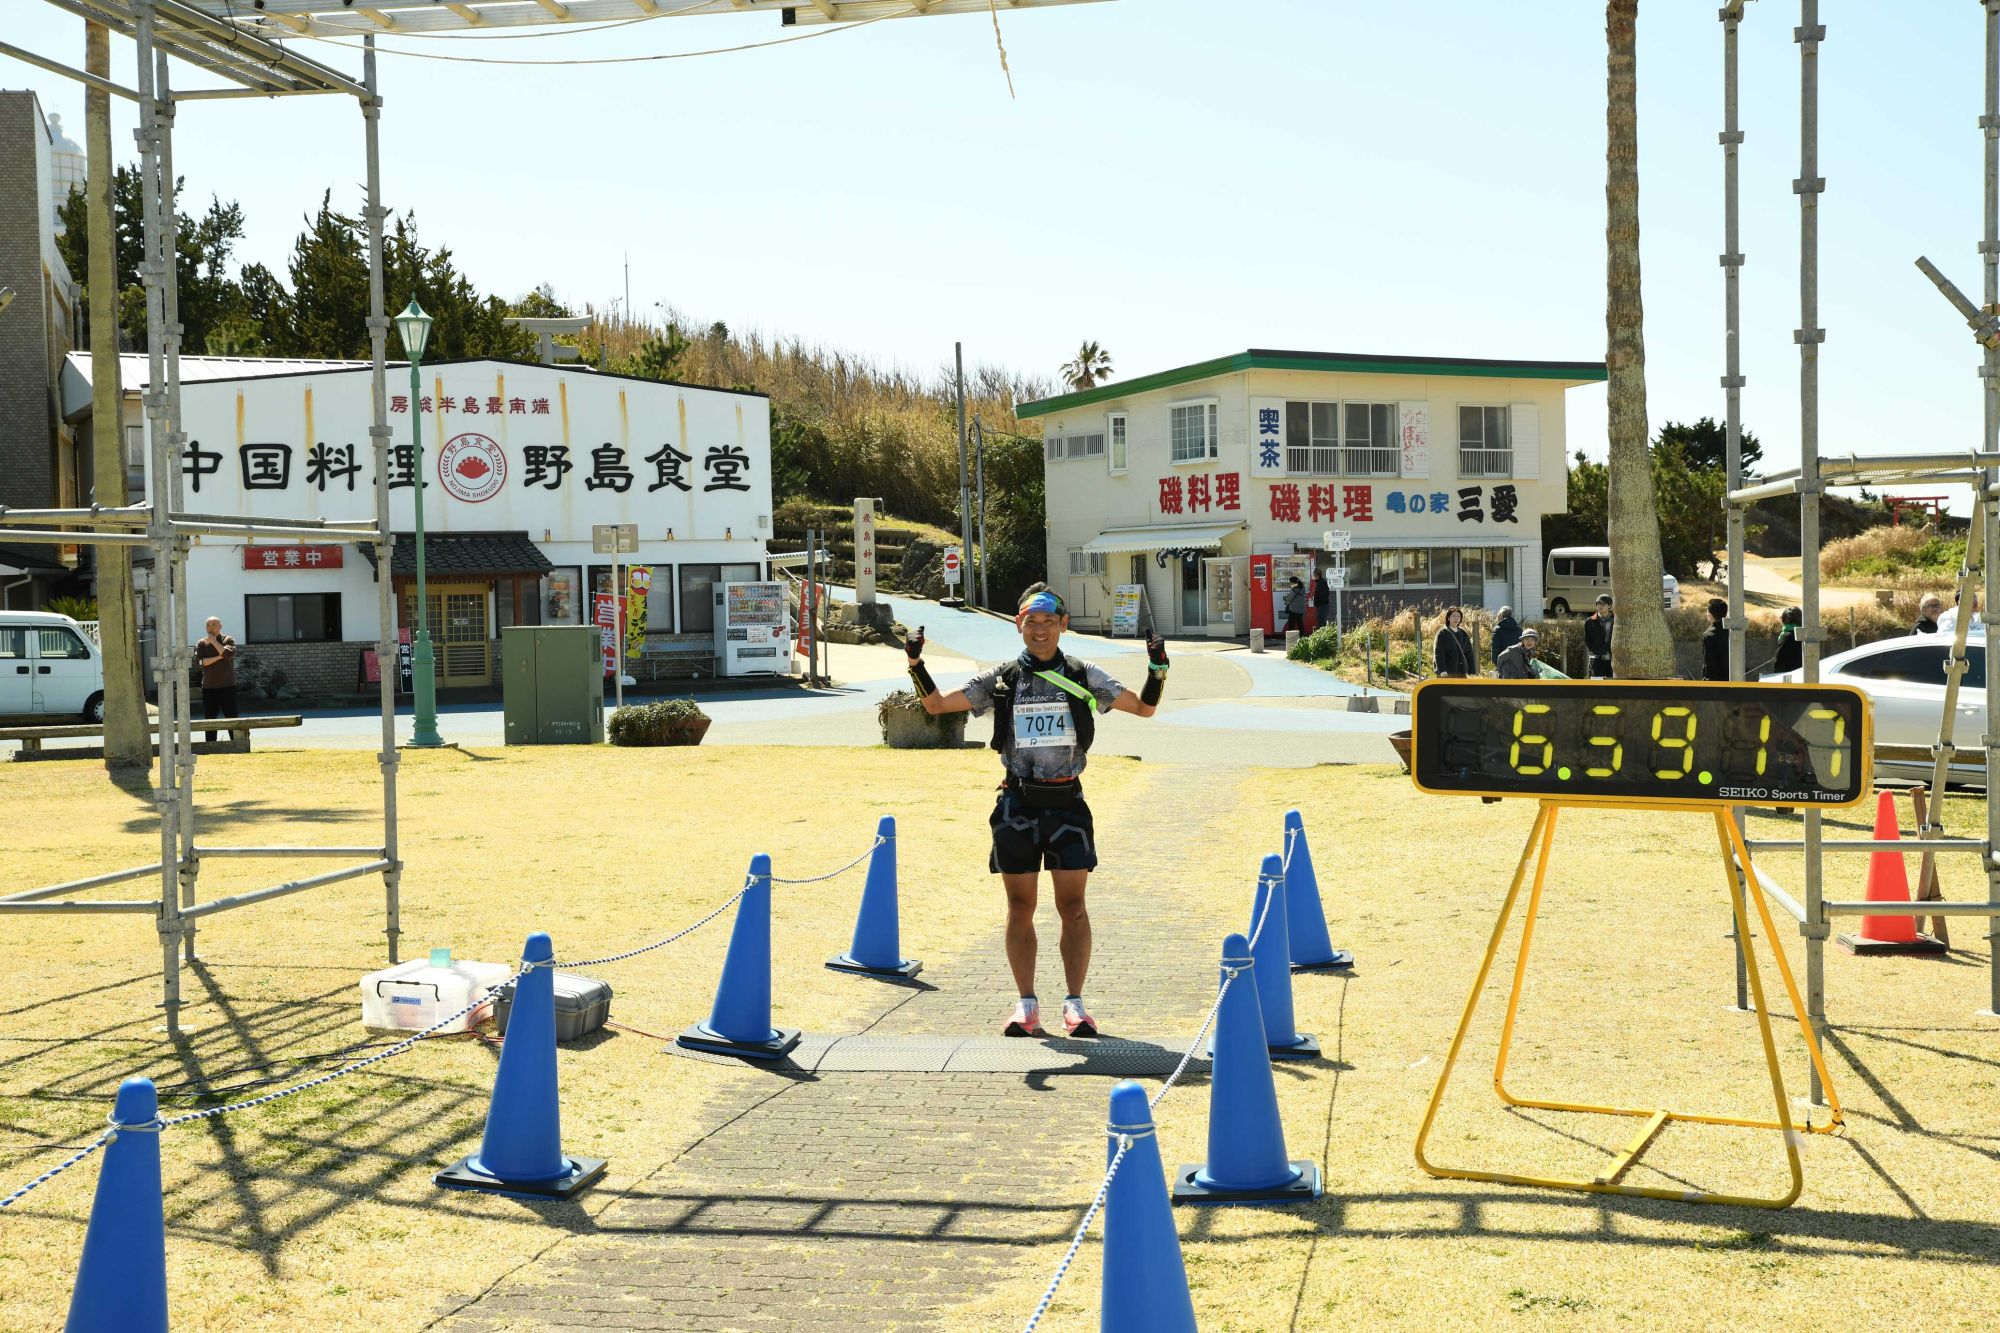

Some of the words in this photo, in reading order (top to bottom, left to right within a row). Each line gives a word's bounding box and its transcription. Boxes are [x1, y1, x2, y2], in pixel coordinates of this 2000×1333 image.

[390, 396, 550, 415] 房総半島最南端
[1258, 408, 1280, 468] 喫茶
[182, 440, 428, 492] 中国料理
[523, 443, 751, 493] 野島食堂
[1159, 472, 1241, 515] 磯料理
[1269, 484, 1374, 523] 磯料理
[1386, 491, 1450, 514] 亀の家
[1457, 485, 1519, 524] 三愛
[262, 550, 323, 567] 営業中
[400, 644, 412, 678] 営業中
[1025, 714, 1066, 733] 7074
[1719, 786, 1768, 799] SEIKO
[1771, 789, 1809, 801] Sports
[1813, 790, 1846, 801] Timer
